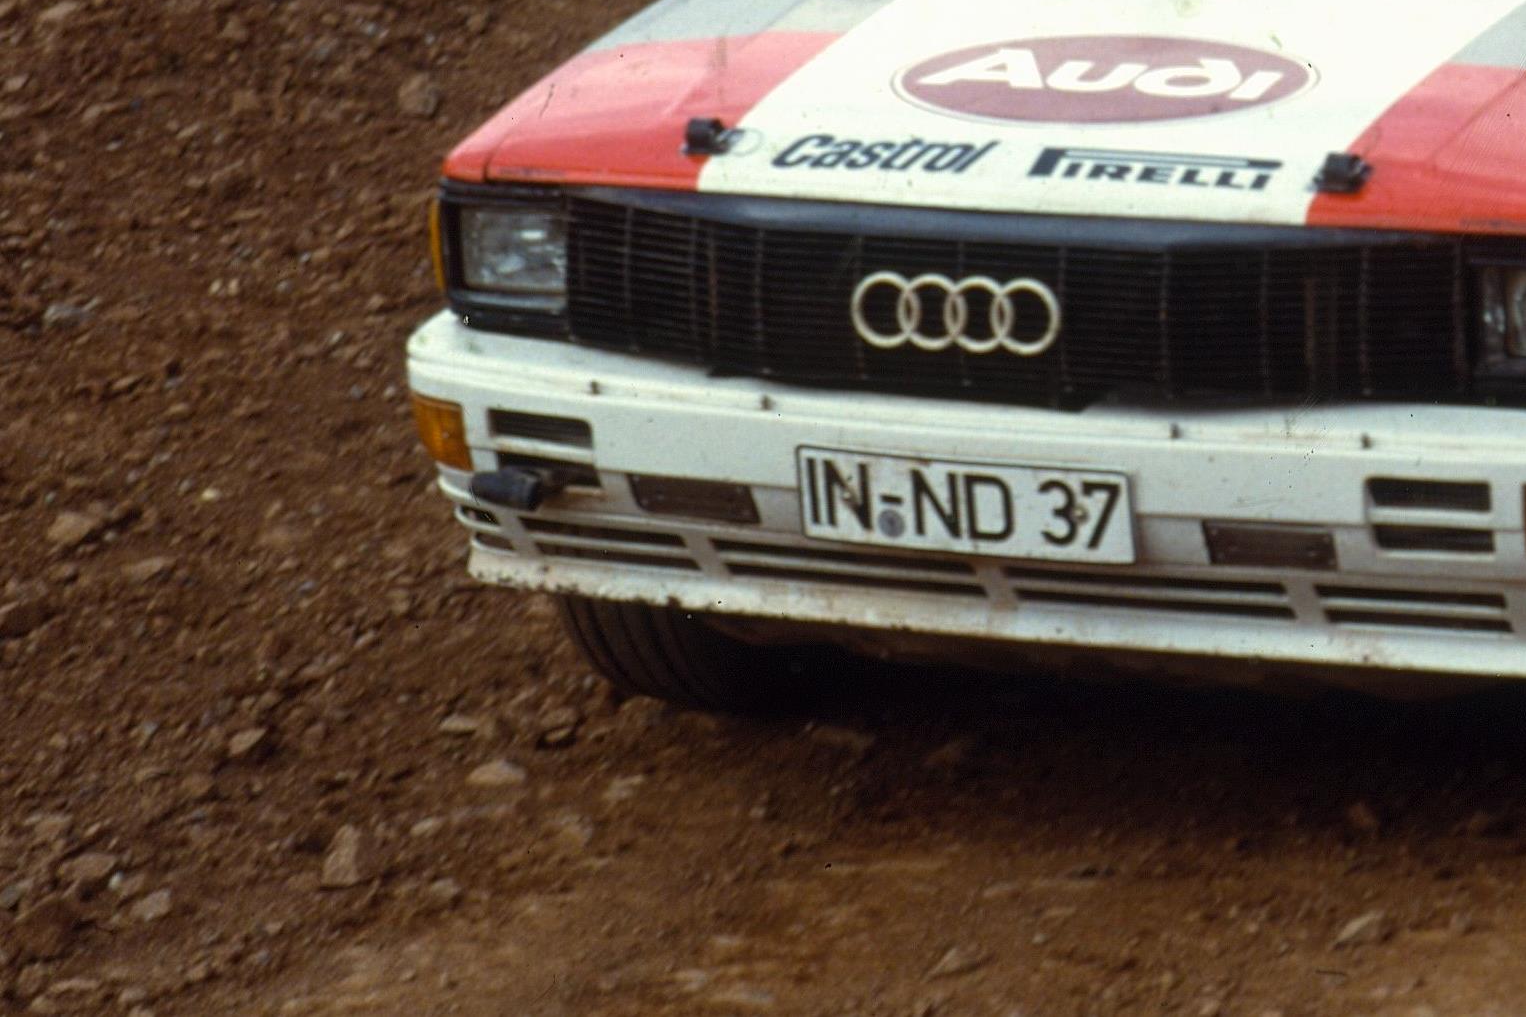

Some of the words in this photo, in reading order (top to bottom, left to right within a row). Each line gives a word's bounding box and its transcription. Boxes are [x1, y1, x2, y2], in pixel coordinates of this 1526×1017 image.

[915, 48, 1283, 101] Audi
[771, 134, 1001, 174] Castrol
[1027, 145, 1282, 192] PIRELLI
[1037, 480, 1122, 549] 37
